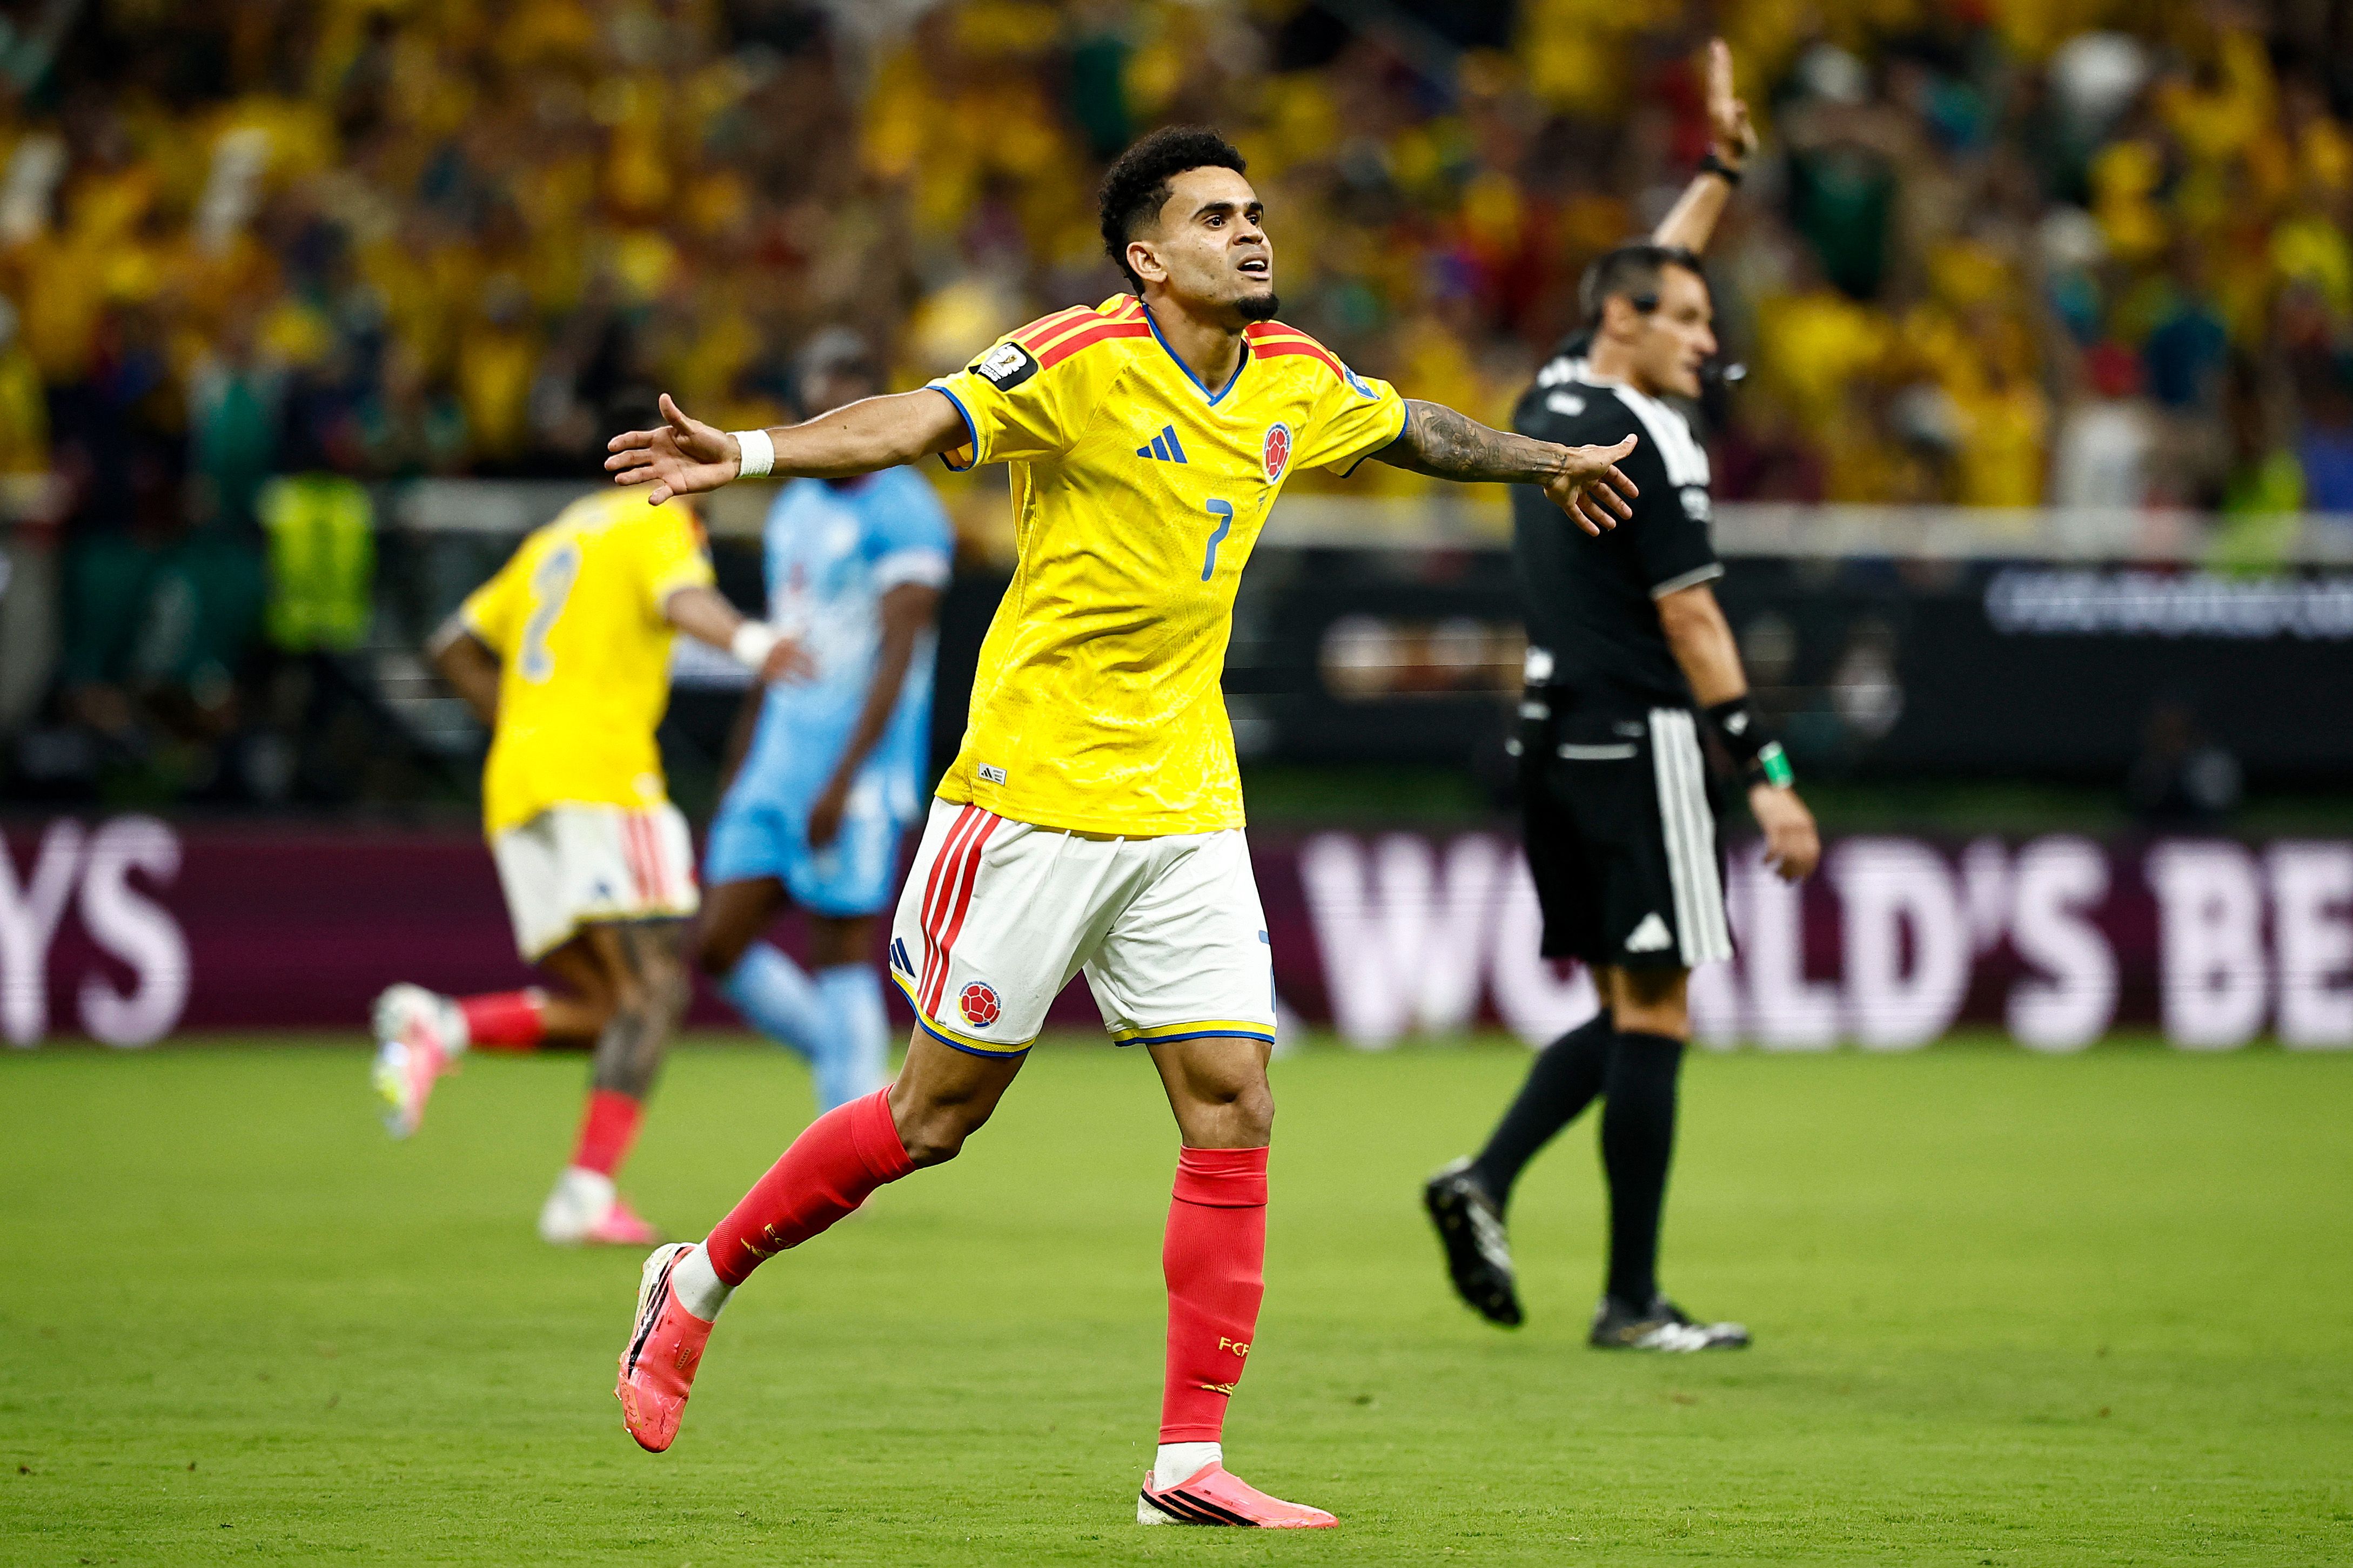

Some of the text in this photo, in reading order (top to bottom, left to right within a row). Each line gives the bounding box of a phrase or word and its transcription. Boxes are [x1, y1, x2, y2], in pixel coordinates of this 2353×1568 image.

[1201, 499, 1234, 582] 7
[0, 815, 191, 1048] YS
[1218, 1336, 1249, 1357] FCF
